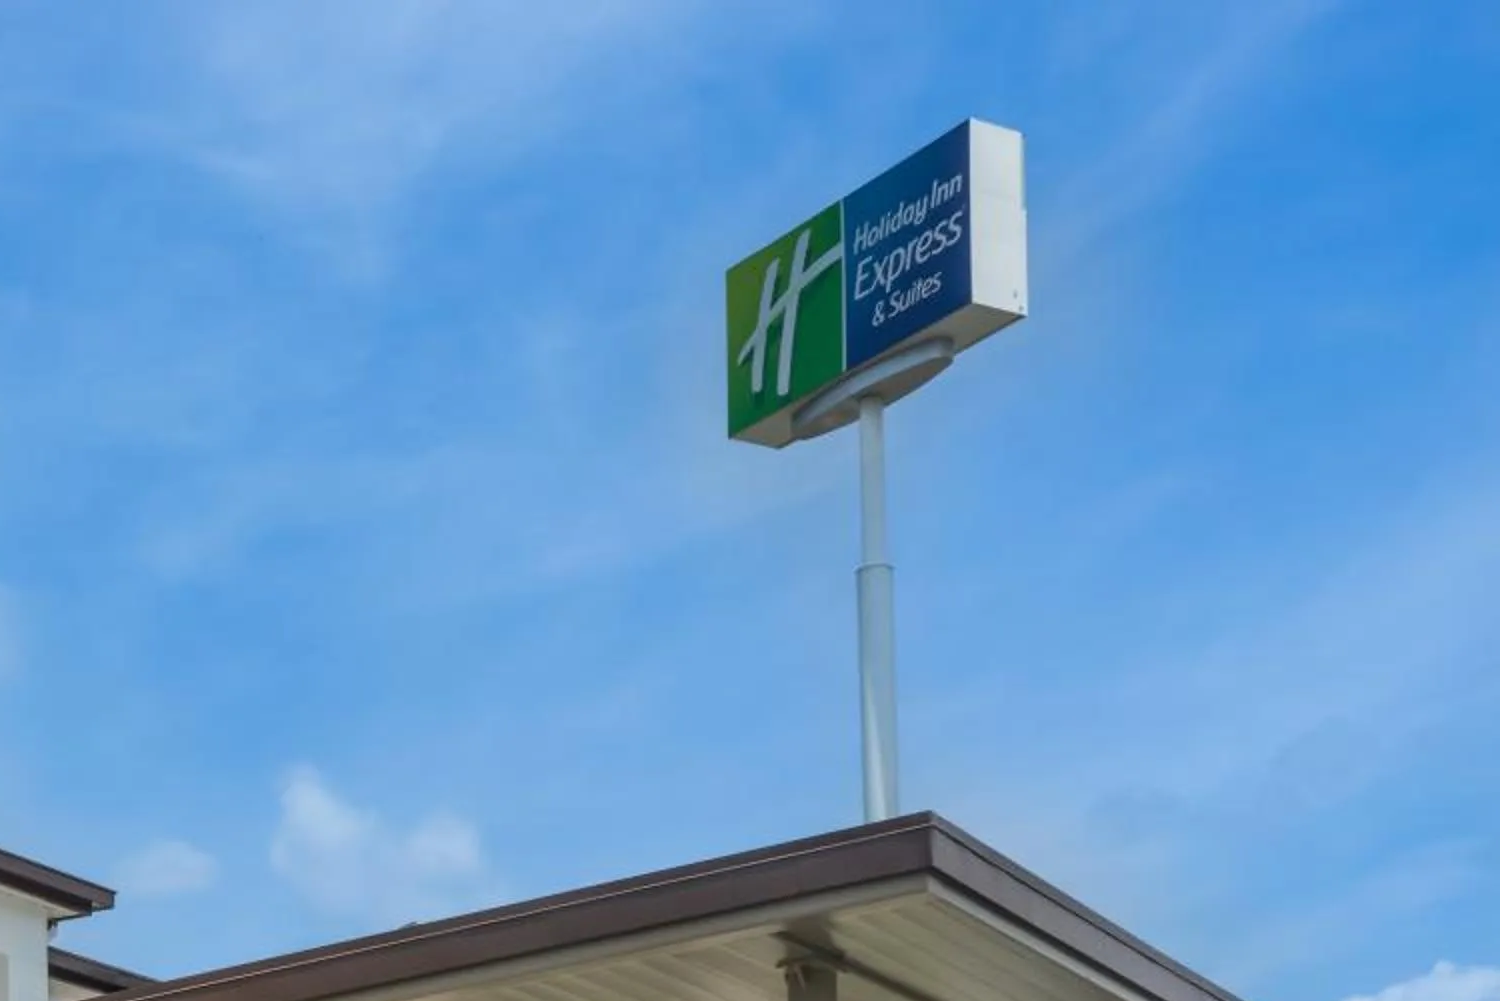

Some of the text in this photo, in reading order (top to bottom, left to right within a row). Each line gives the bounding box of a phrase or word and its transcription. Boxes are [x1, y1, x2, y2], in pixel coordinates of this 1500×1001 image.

[853, 174, 962, 254] Holiday Inn
[854, 210, 963, 301] Express
[737, 228, 842, 396] H
[871, 271, 942, 326] & Suites
